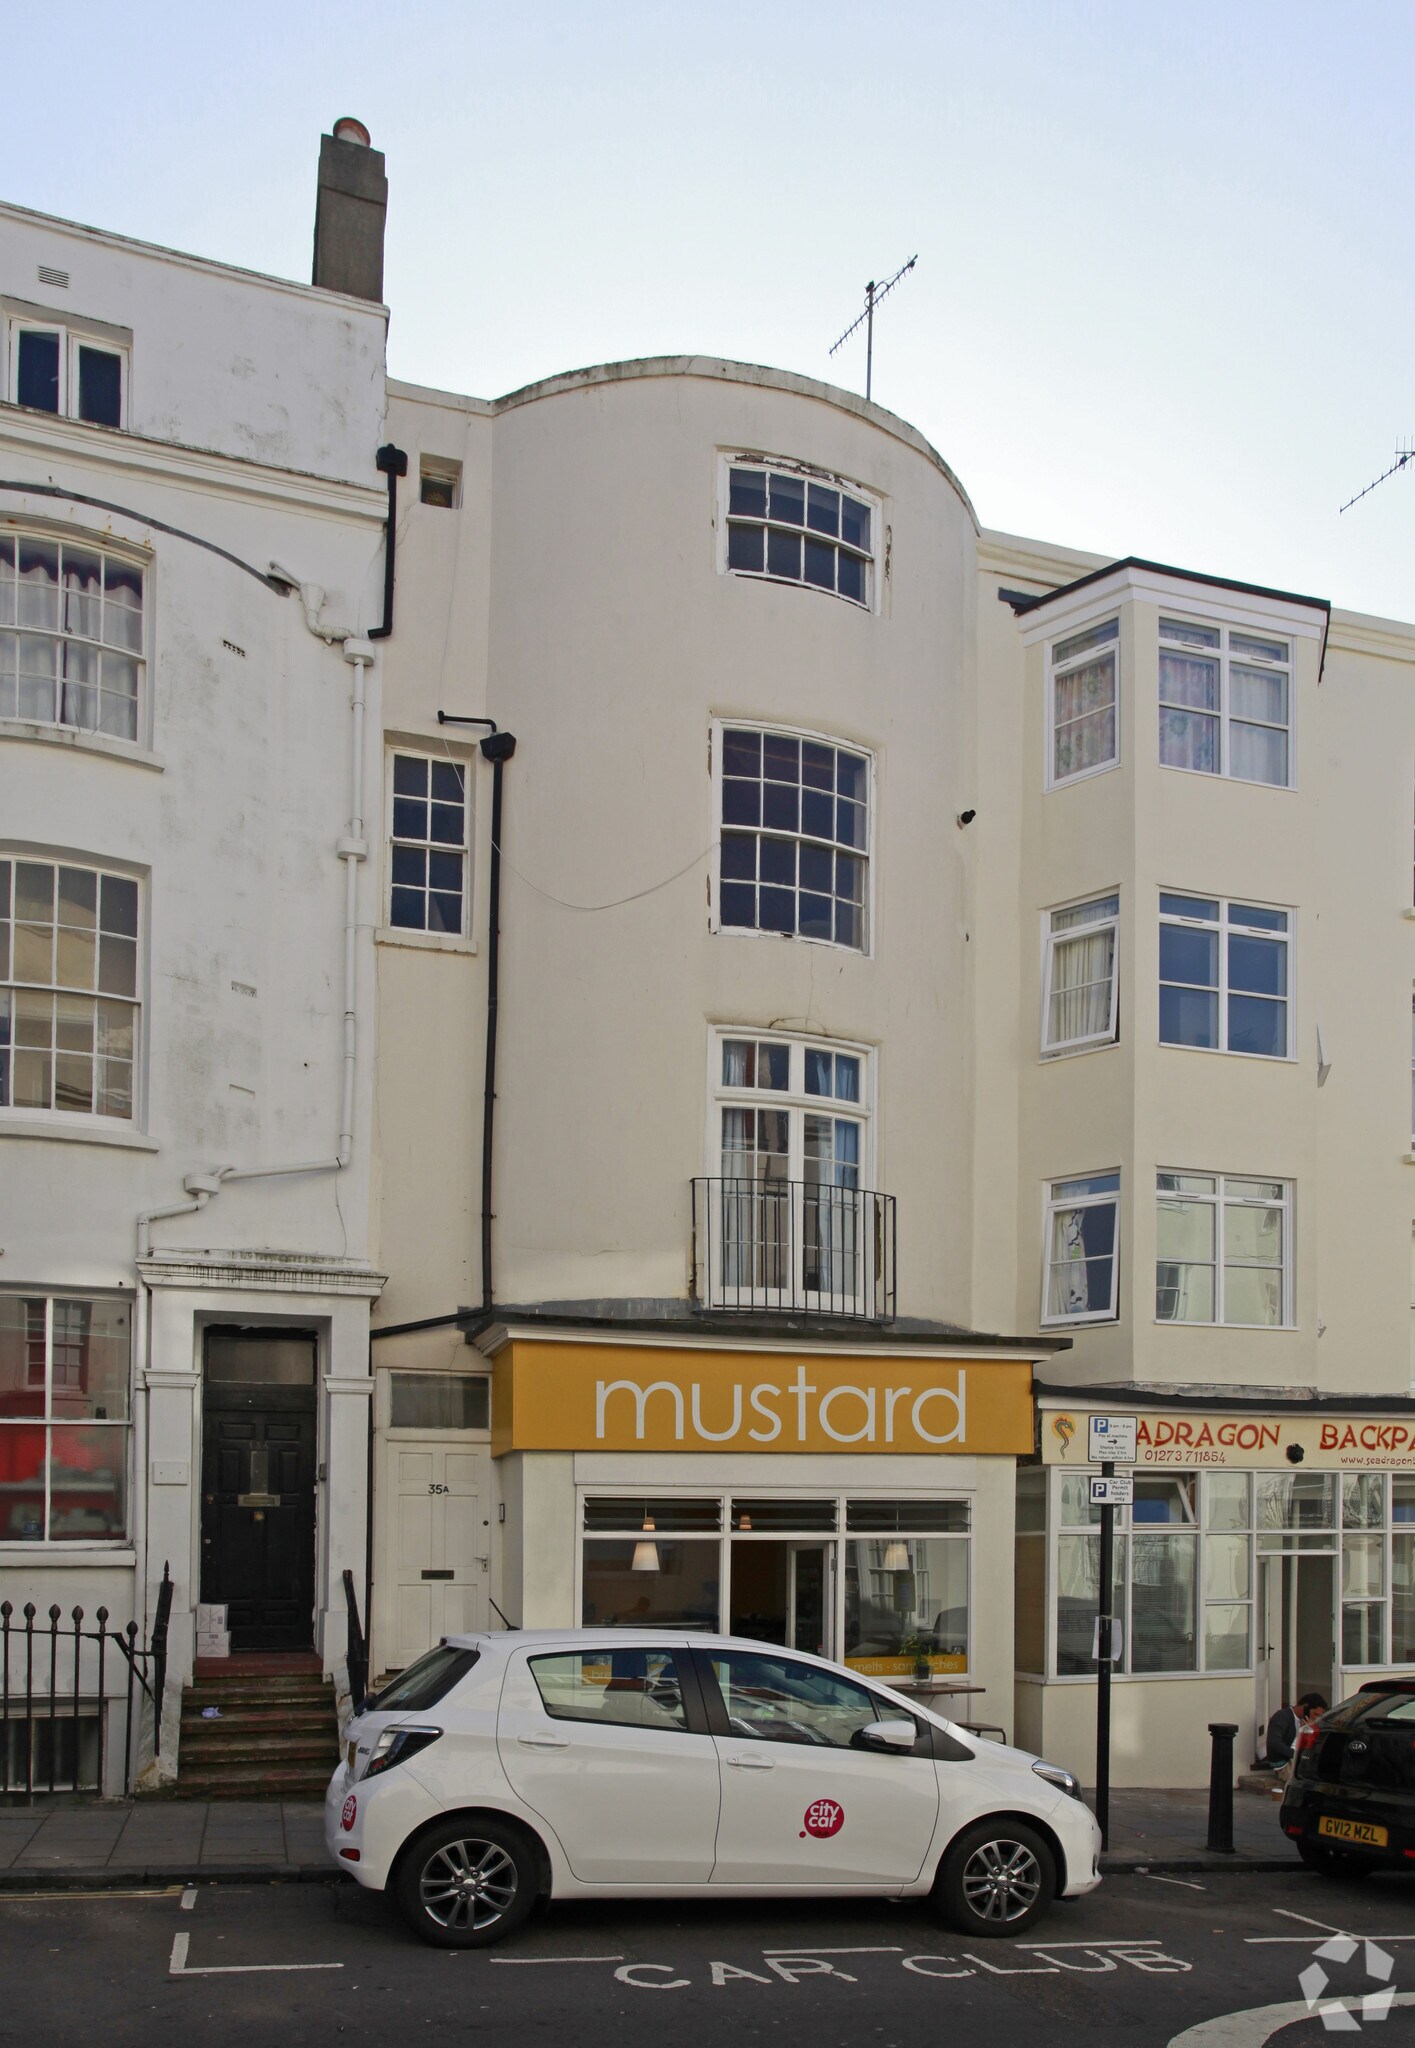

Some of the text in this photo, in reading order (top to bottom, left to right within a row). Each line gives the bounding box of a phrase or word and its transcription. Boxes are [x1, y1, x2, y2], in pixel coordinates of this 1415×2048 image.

[595, 1366, 966, 1443] mustard
[1145, 1450, 1226, 1463] 01273 711854
[428, 1484, 450, 1494] 35A
[854, 1662, 883, 1672] melts
[810, 1801, 840, 1818] city
[808, 1816, 837, 1828] car
[1326, 1819, 1378, 1842] GV12 MZL
[613, 1949, 1193, 1989] CAR CLUB
